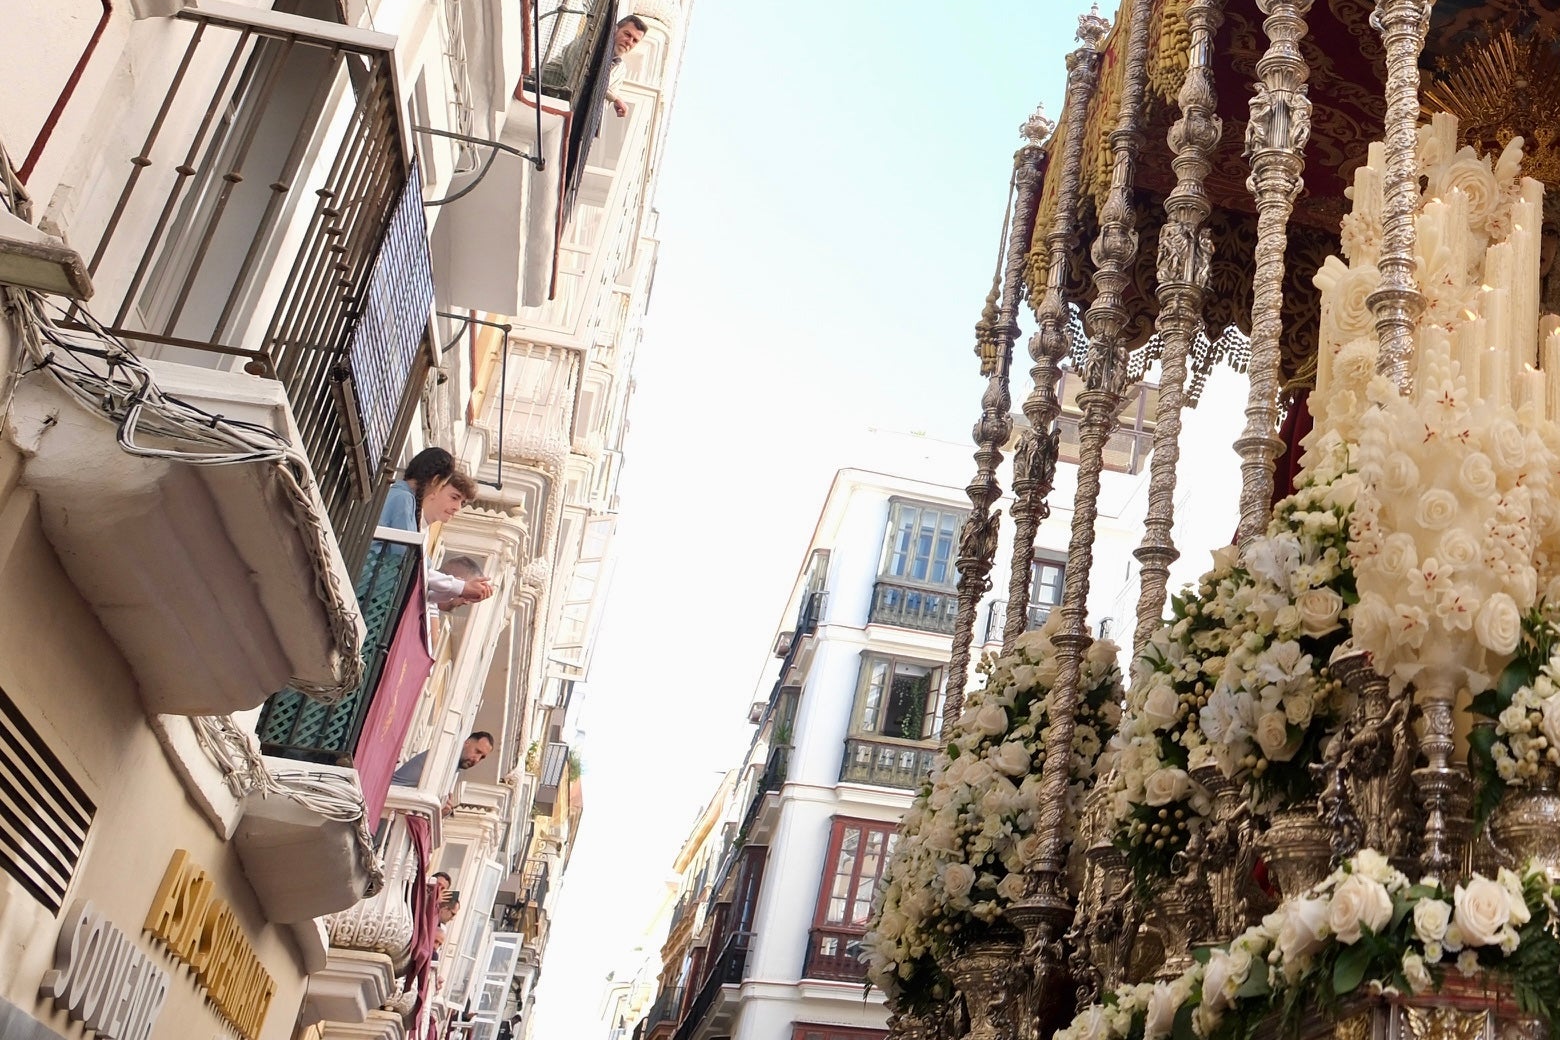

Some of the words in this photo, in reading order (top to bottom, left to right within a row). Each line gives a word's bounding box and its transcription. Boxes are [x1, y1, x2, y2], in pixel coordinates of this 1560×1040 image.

[45, 898, 171, 1040] SOUVENIR
[145, 848, 216, 965] ASIA
[196, 898, 278, 1040] SUPERMARKET
